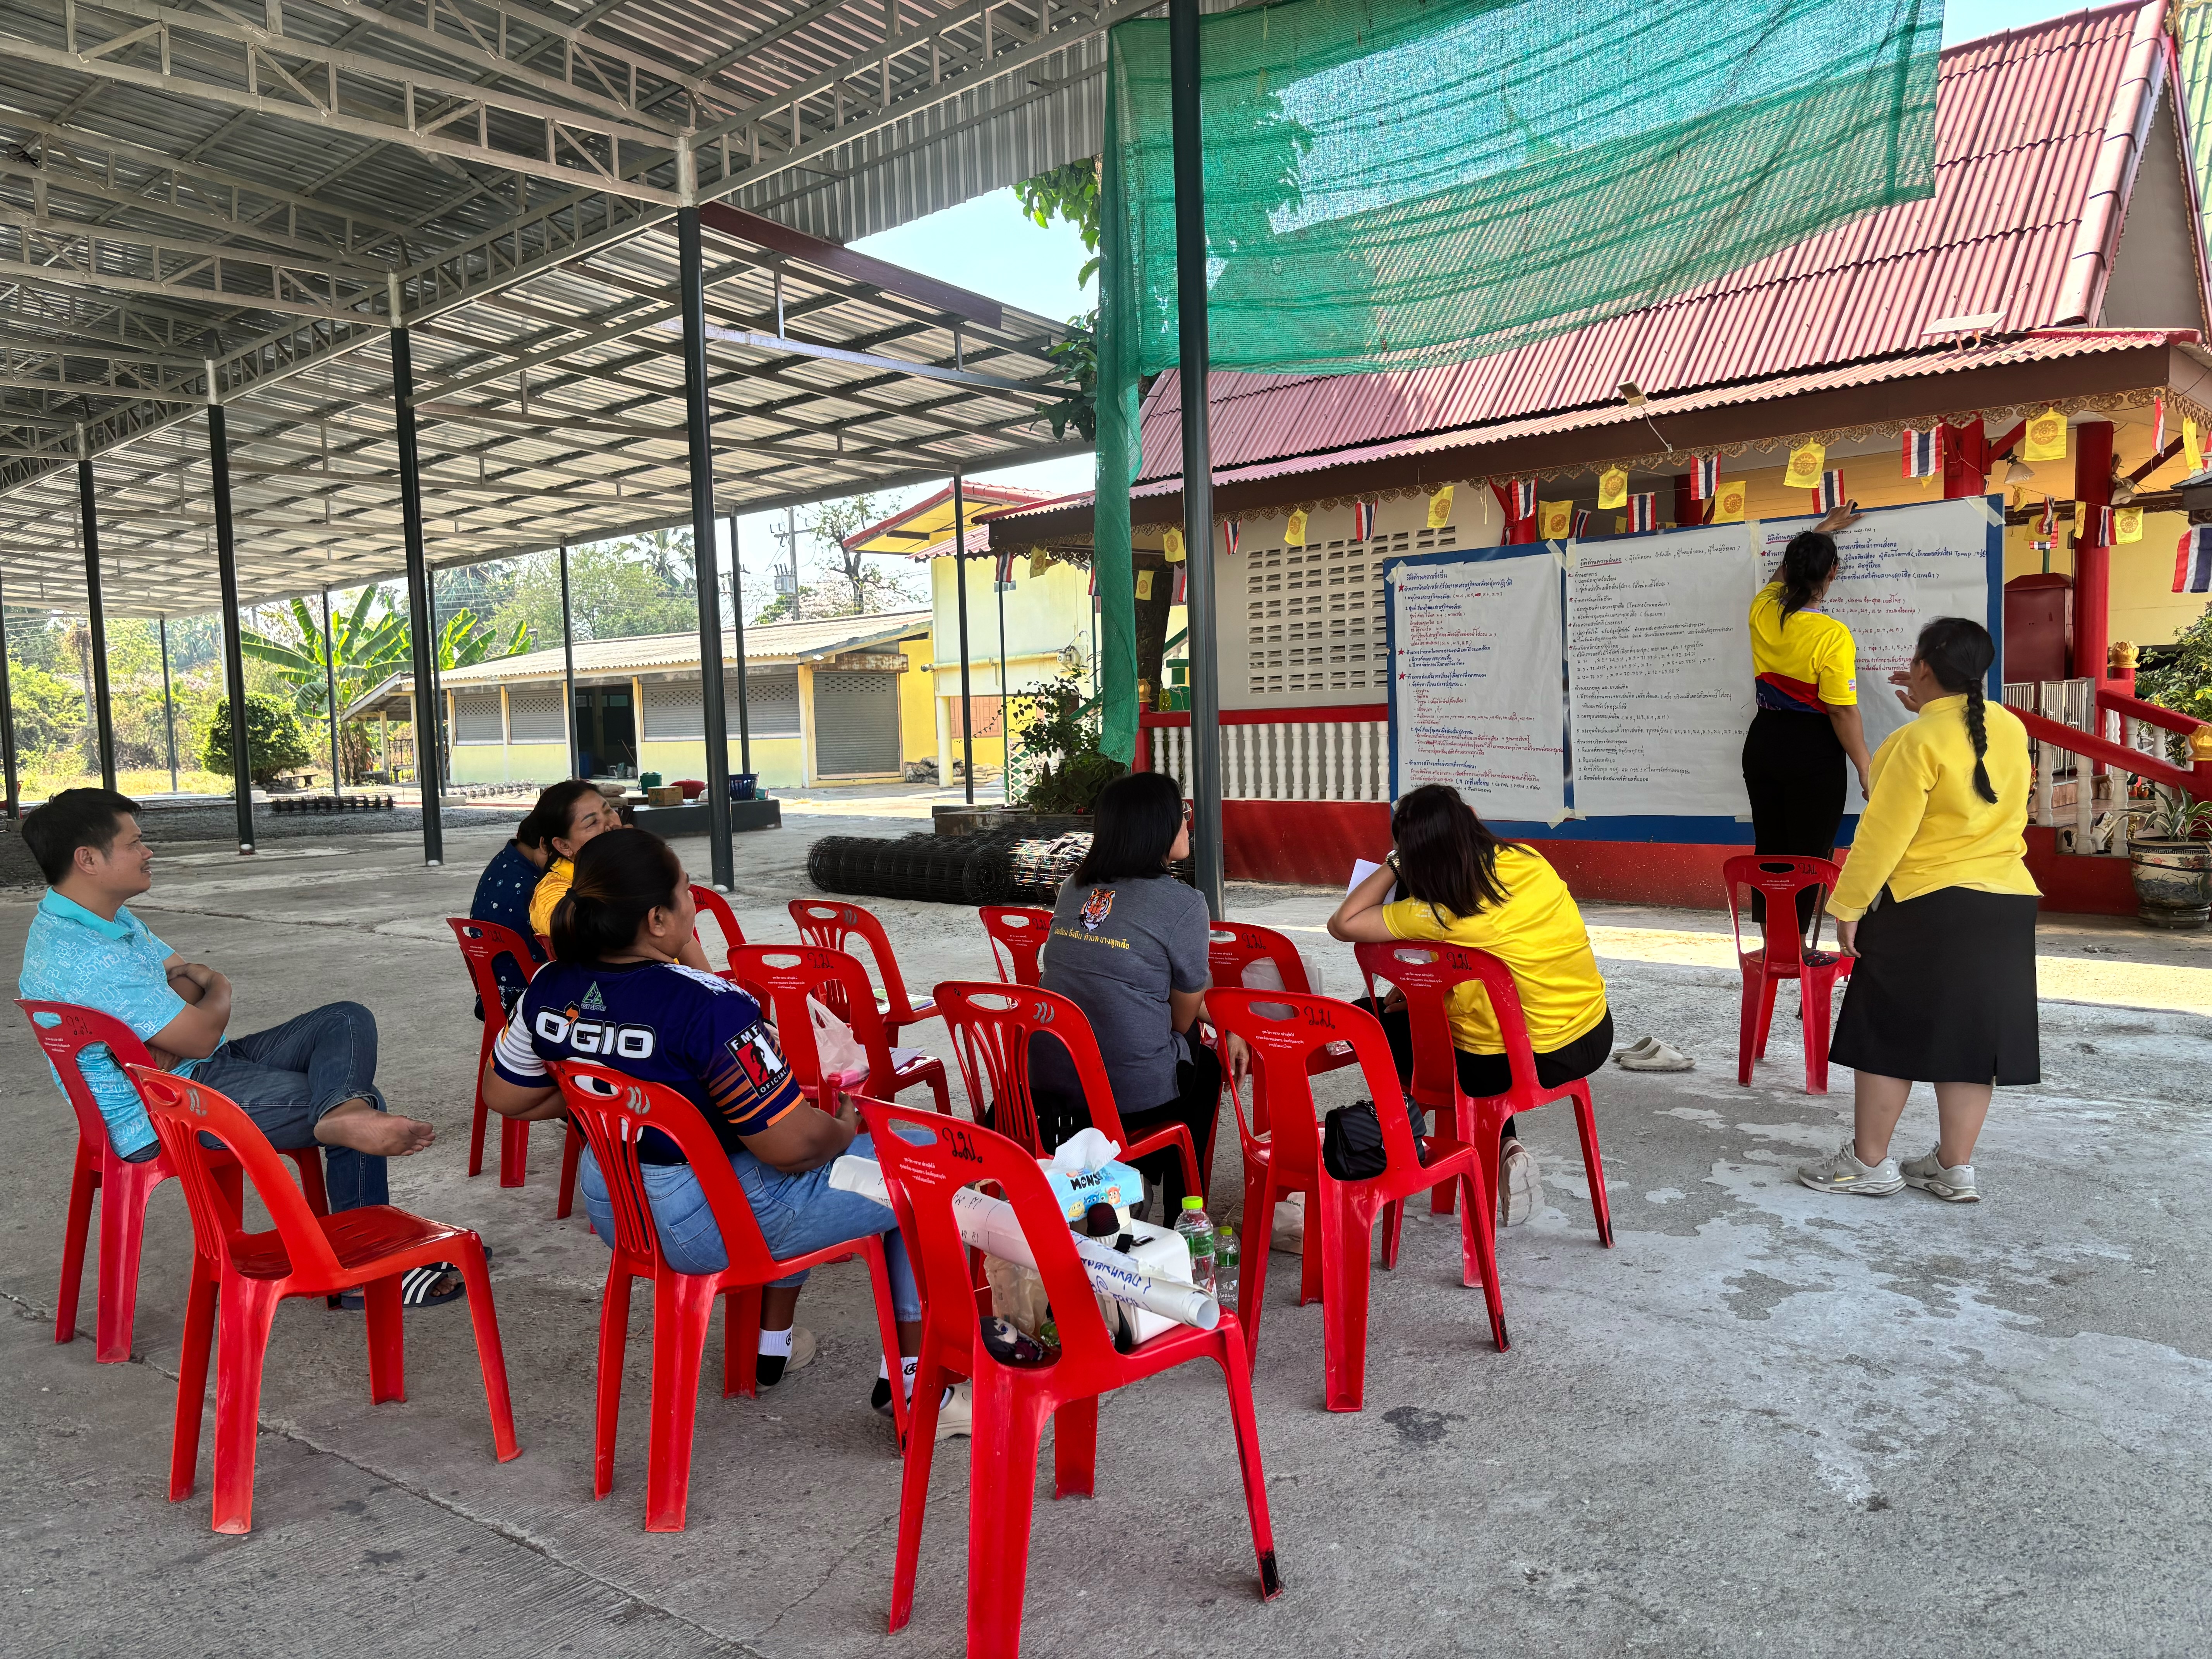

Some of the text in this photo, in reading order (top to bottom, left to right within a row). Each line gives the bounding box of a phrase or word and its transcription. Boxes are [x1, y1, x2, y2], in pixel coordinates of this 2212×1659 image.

[1084, 933, 1099, 942] ตำบล
[1099, 937, 1130, 950] บางลูกเสือ
[730, 1025, 759, 1051] FMF
[760, 1069, 787, 1093] OFICIAL
